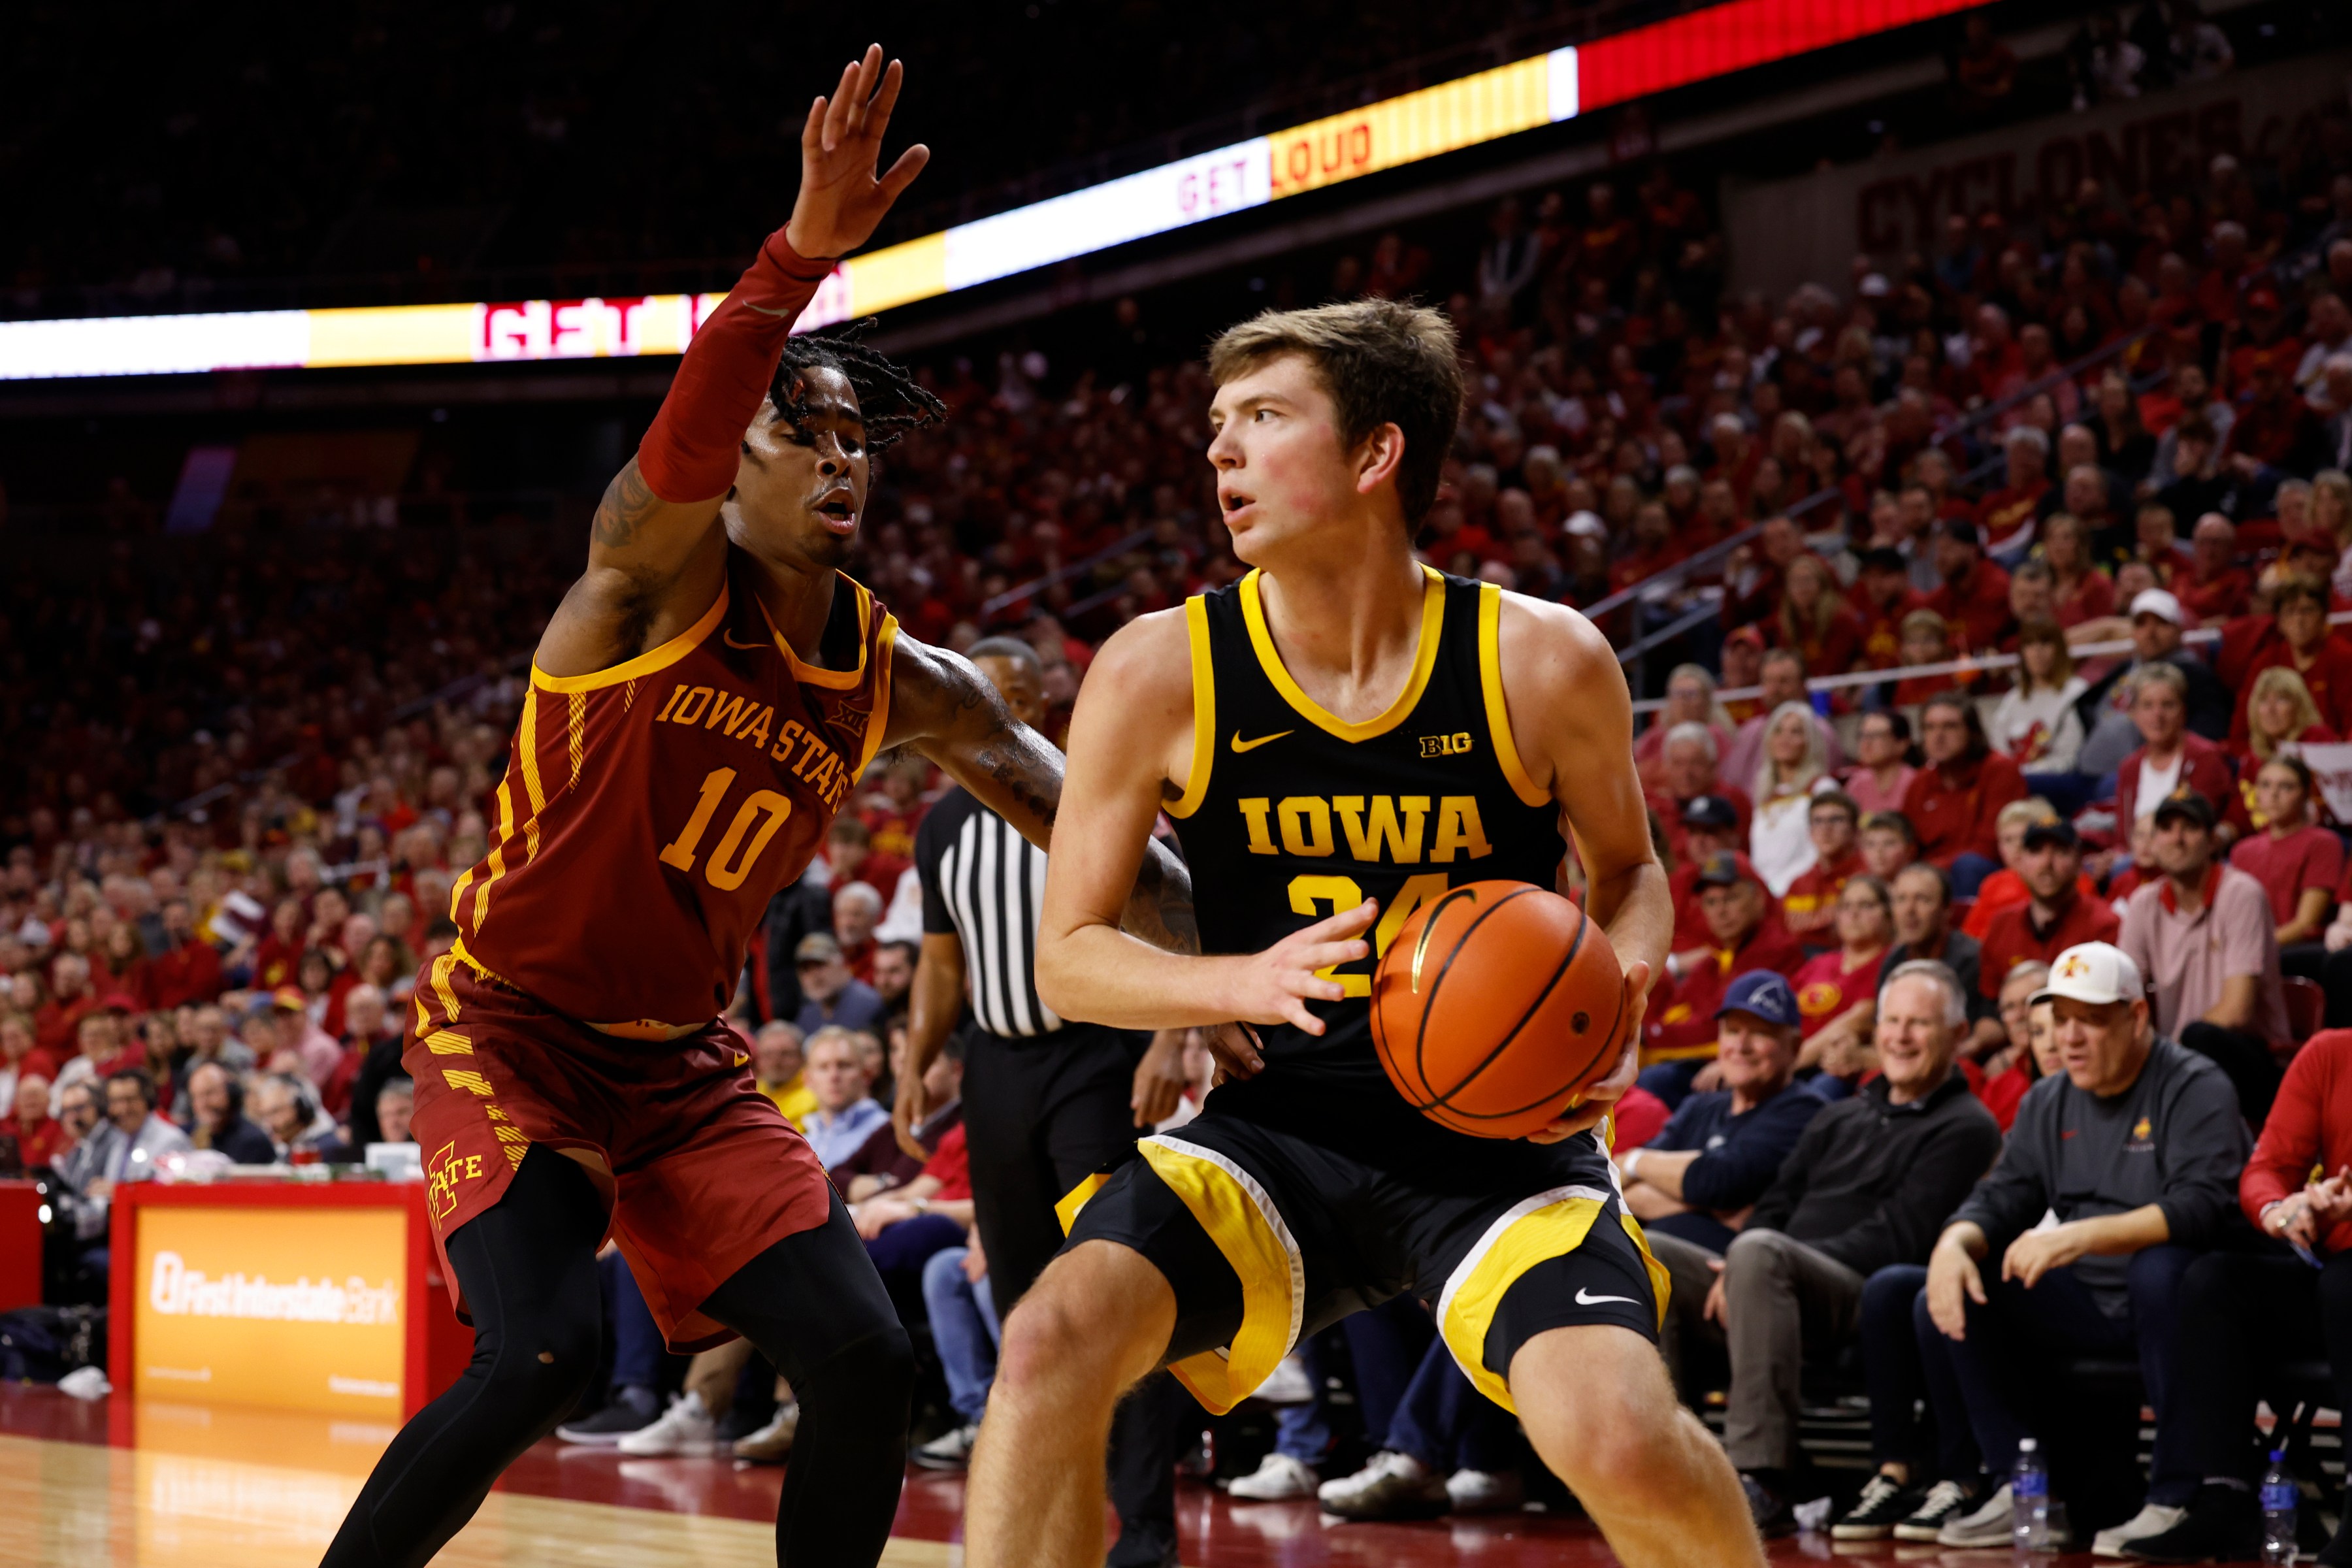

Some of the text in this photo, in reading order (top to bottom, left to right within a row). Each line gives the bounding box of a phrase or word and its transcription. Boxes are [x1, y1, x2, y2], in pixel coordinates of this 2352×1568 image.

[1178, 123, 1371, 213] GET LOUD
[478, 297, 649, 361] GET
[655, 684, 774, 749] IOWA
[659, 766, 791, 891] 10
[1238, 795, 1493, 864] IOWA
